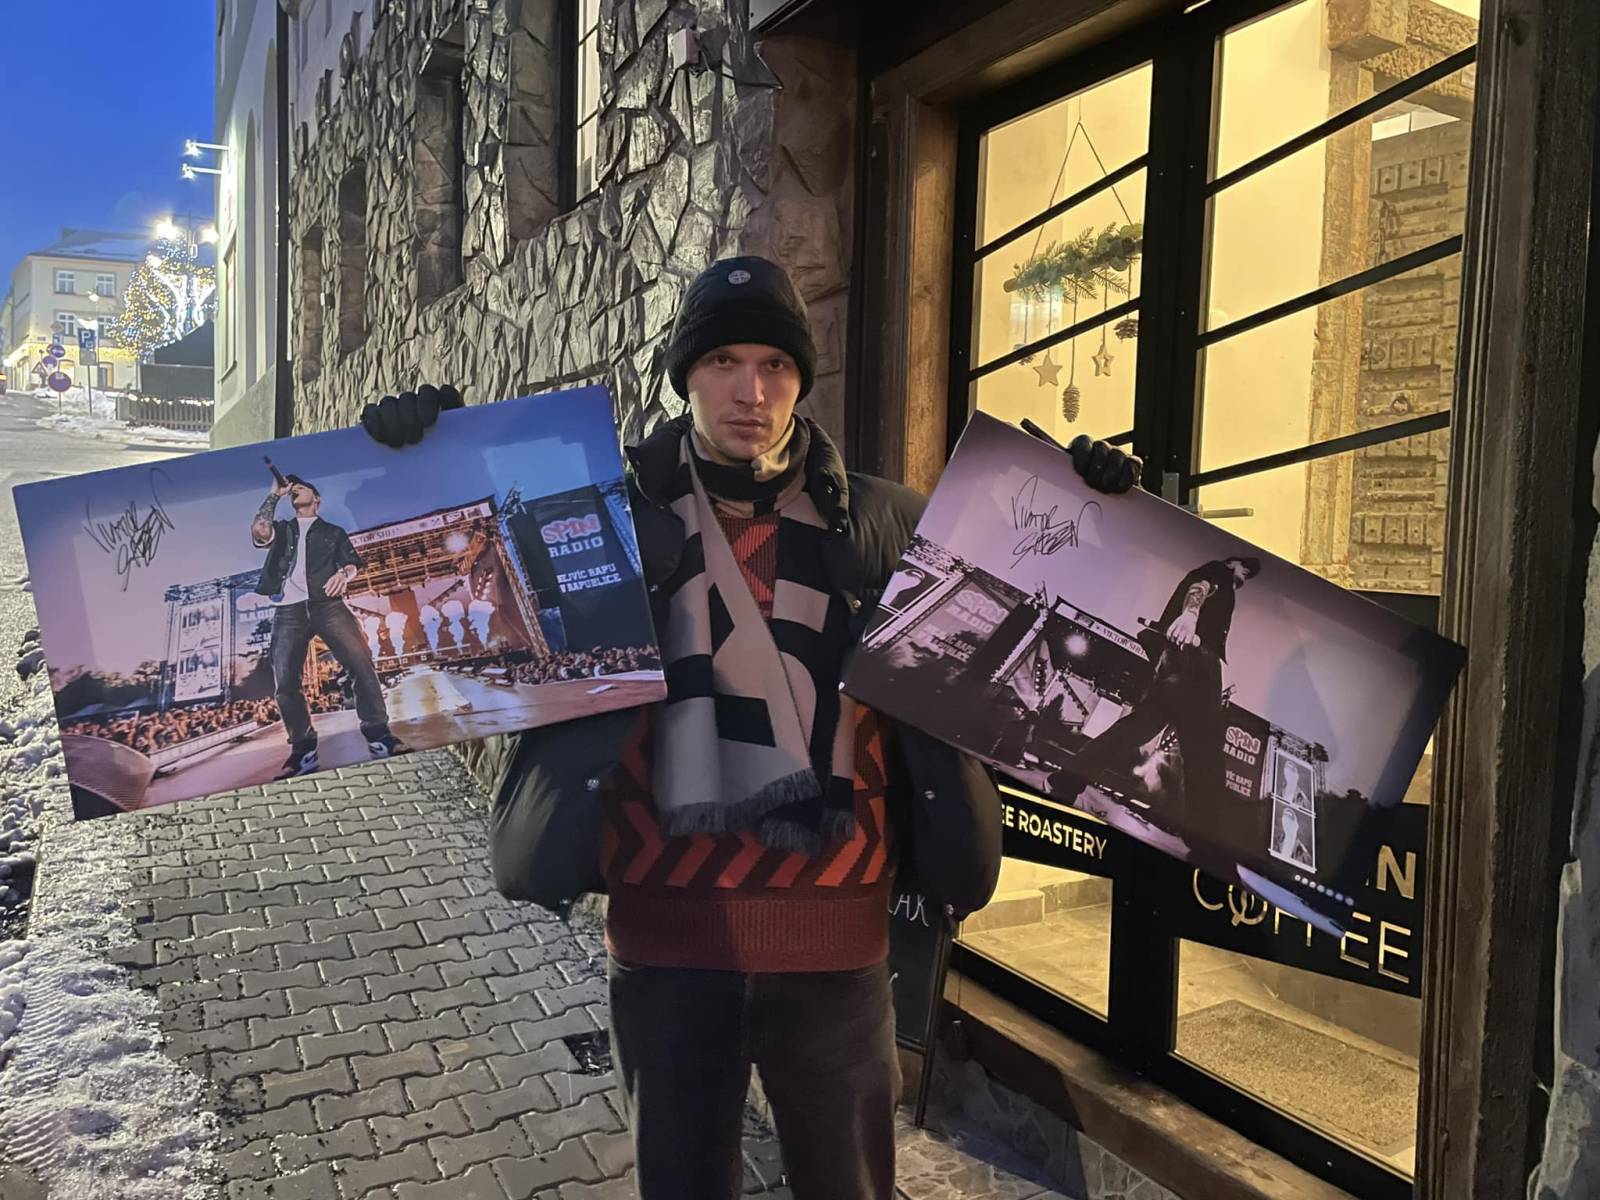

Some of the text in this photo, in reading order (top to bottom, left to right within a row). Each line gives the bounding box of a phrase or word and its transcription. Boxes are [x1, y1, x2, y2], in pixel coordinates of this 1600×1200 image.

[81, 331, 91, 343] P
[547, 536, 605, 558] RADIO
[1225, 726, 1261, 754] SPIN
[1223, 743, 1256, 765] RADIO
[1018, 810, 1107, 860] ROASTERY
